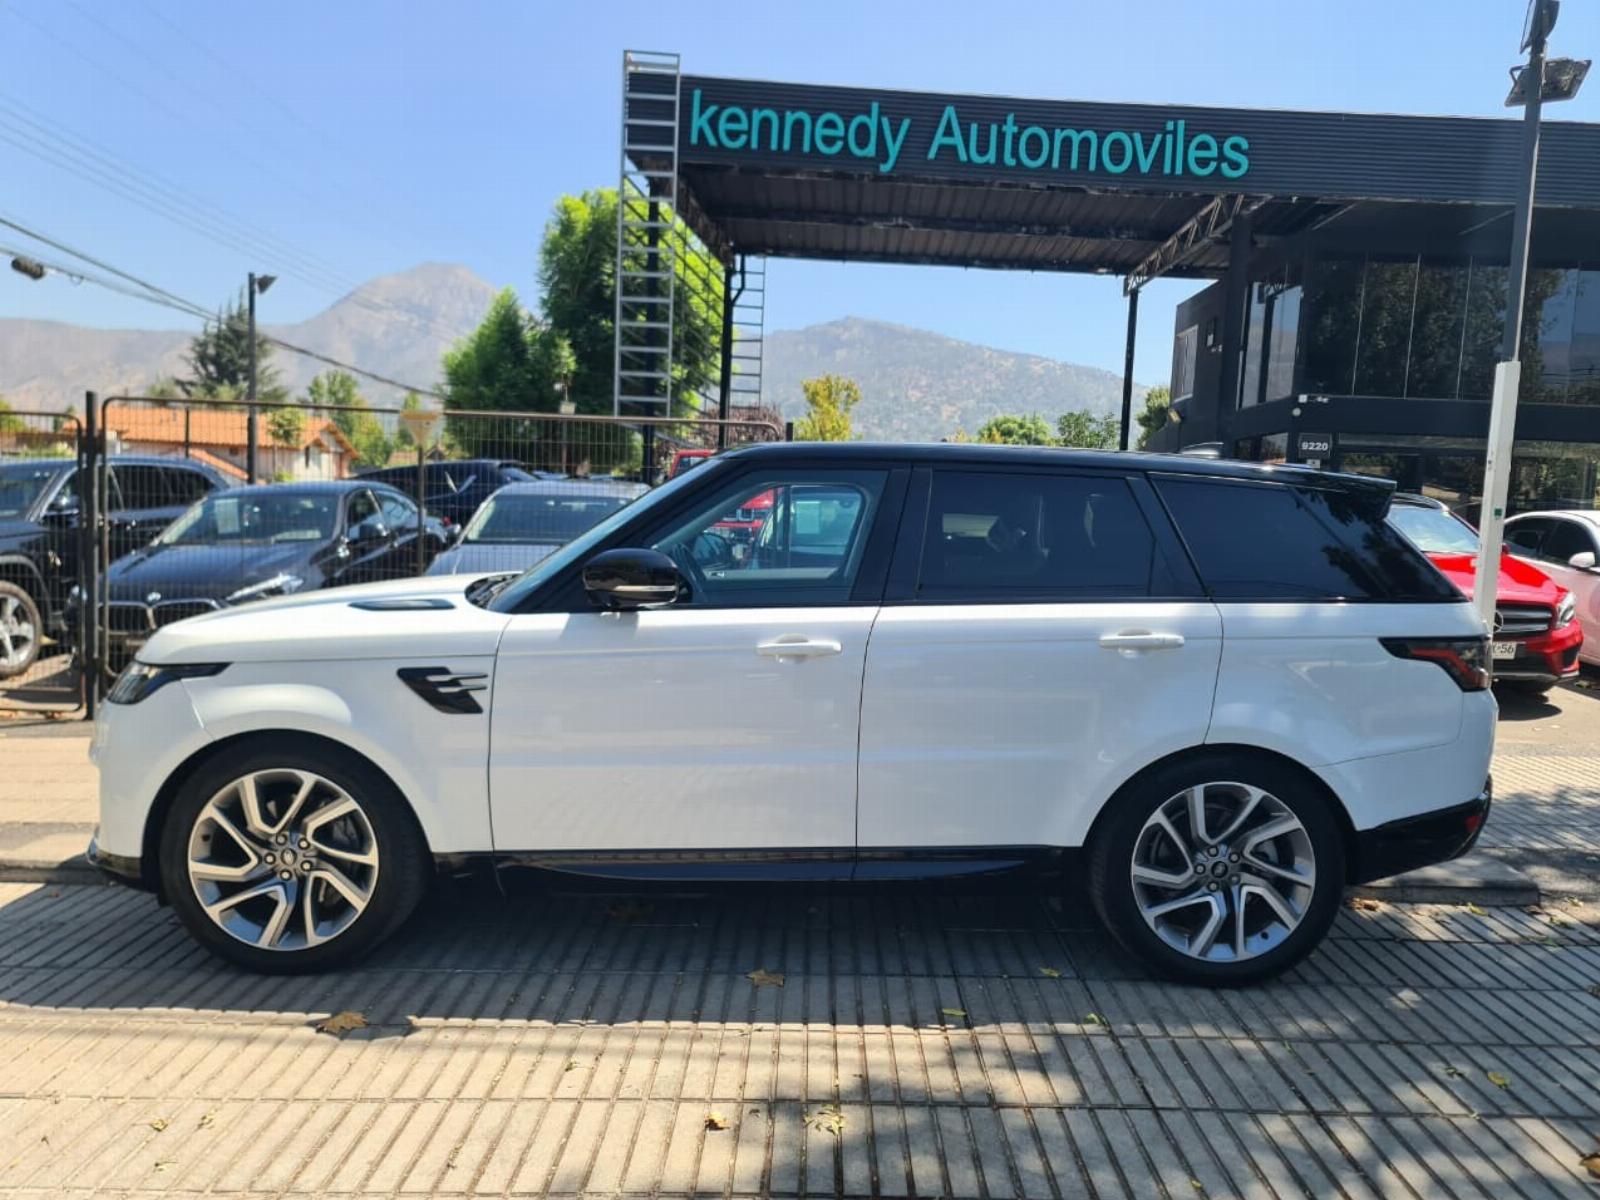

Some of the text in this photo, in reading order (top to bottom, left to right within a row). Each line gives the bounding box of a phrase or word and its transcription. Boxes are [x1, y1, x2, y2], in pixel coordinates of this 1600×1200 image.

[690, 89, 1250, 179] kennedy Automoviles
[1301, 441, 1329, 451] 9220
